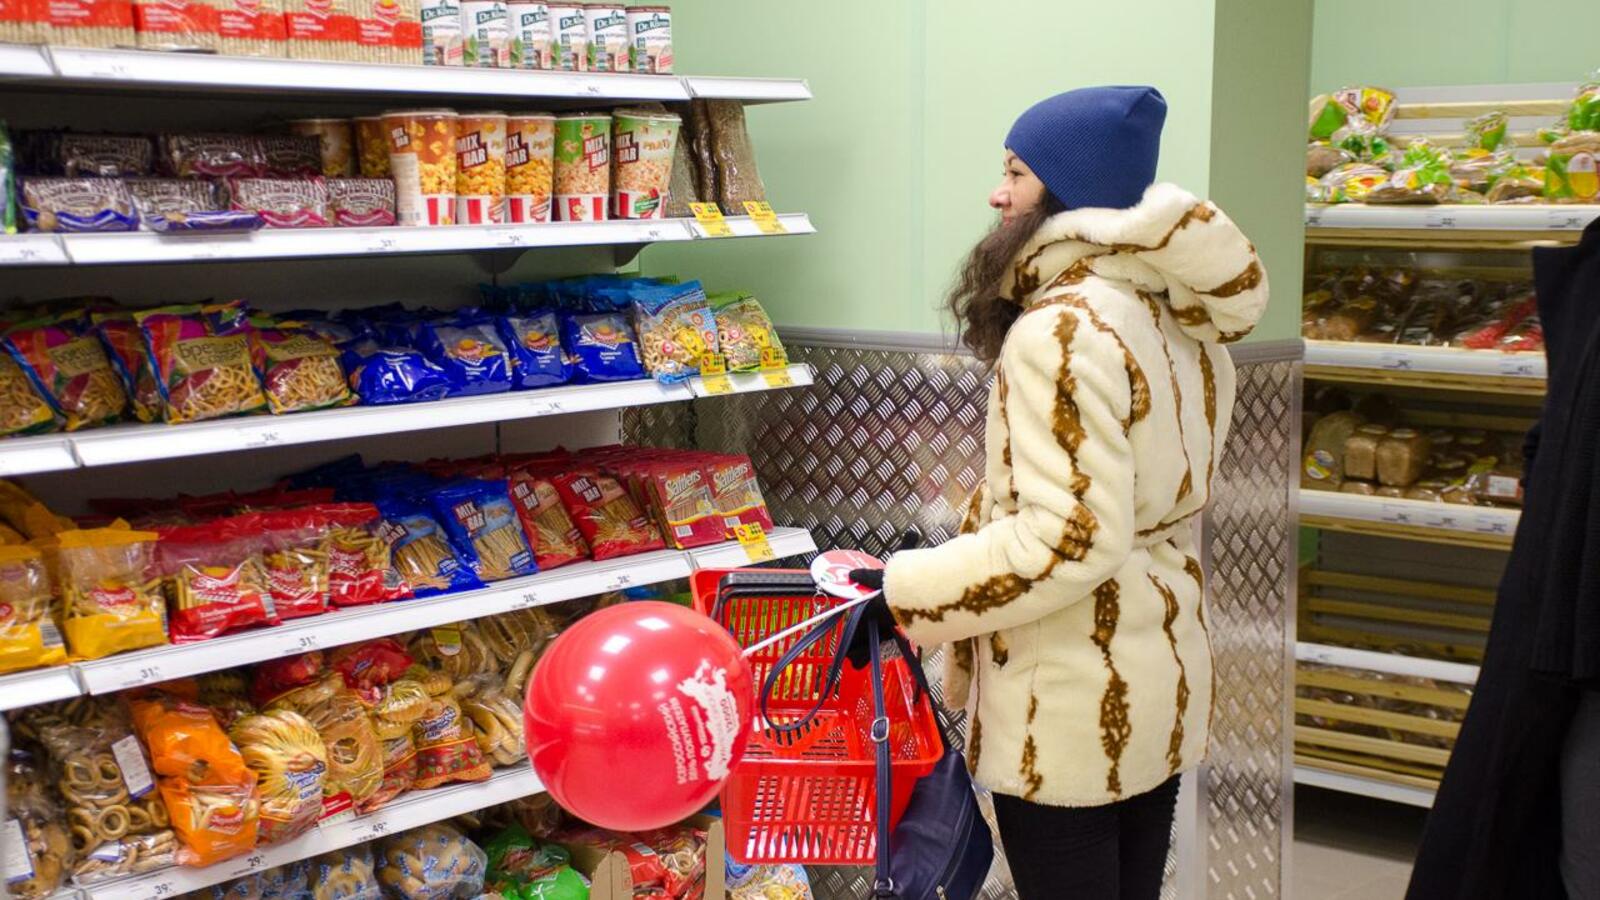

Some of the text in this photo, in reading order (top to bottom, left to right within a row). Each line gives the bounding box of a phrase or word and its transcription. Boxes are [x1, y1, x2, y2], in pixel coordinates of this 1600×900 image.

[507, 134, 520, 152] IX
[463, 148, 486, 168] BAR
[514, 482, 530, 499] MIX
[571, 477, 591, 495] MIX
[582, 486, 601, 503] BAR
[455, 501, 477, 520] MIX
[523, 493, 539, 510] BAR
[467, 512, 486, 532] BAR
